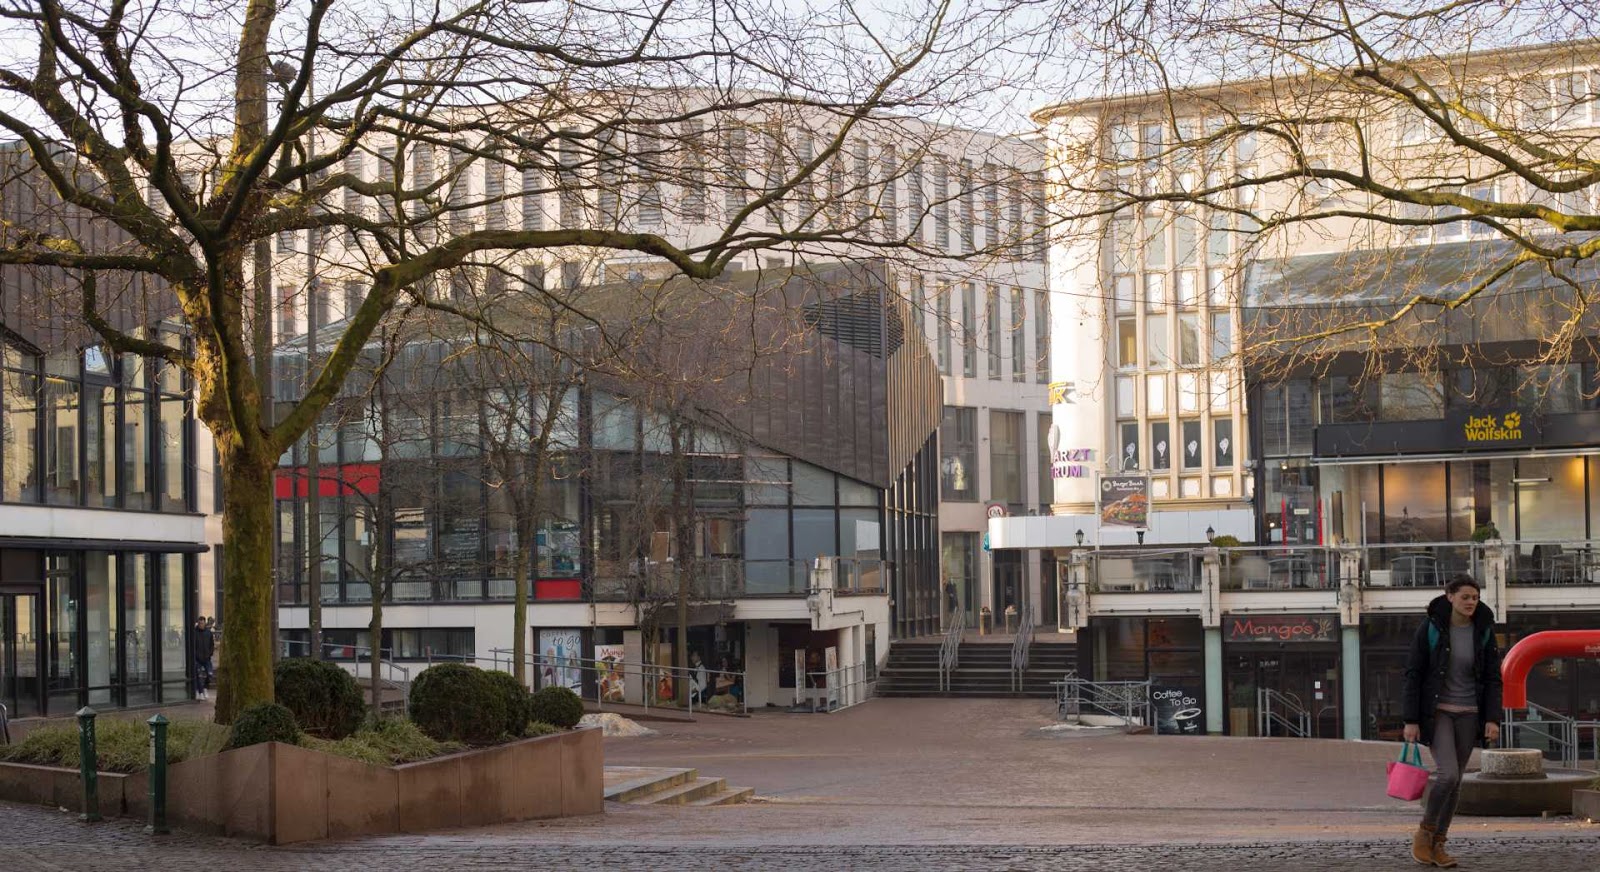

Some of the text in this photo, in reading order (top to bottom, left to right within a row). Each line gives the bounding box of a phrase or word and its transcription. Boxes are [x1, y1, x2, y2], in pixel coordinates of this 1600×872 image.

[1465, 415, 1497, 428] Jack
[1465, 427, 1522, 441] Wolfskin
[1232, 620, 1314, 640] Mango's
[1153, 690, 1183, 700] Coffee
[1170, 696, 1197, 706] To Go
